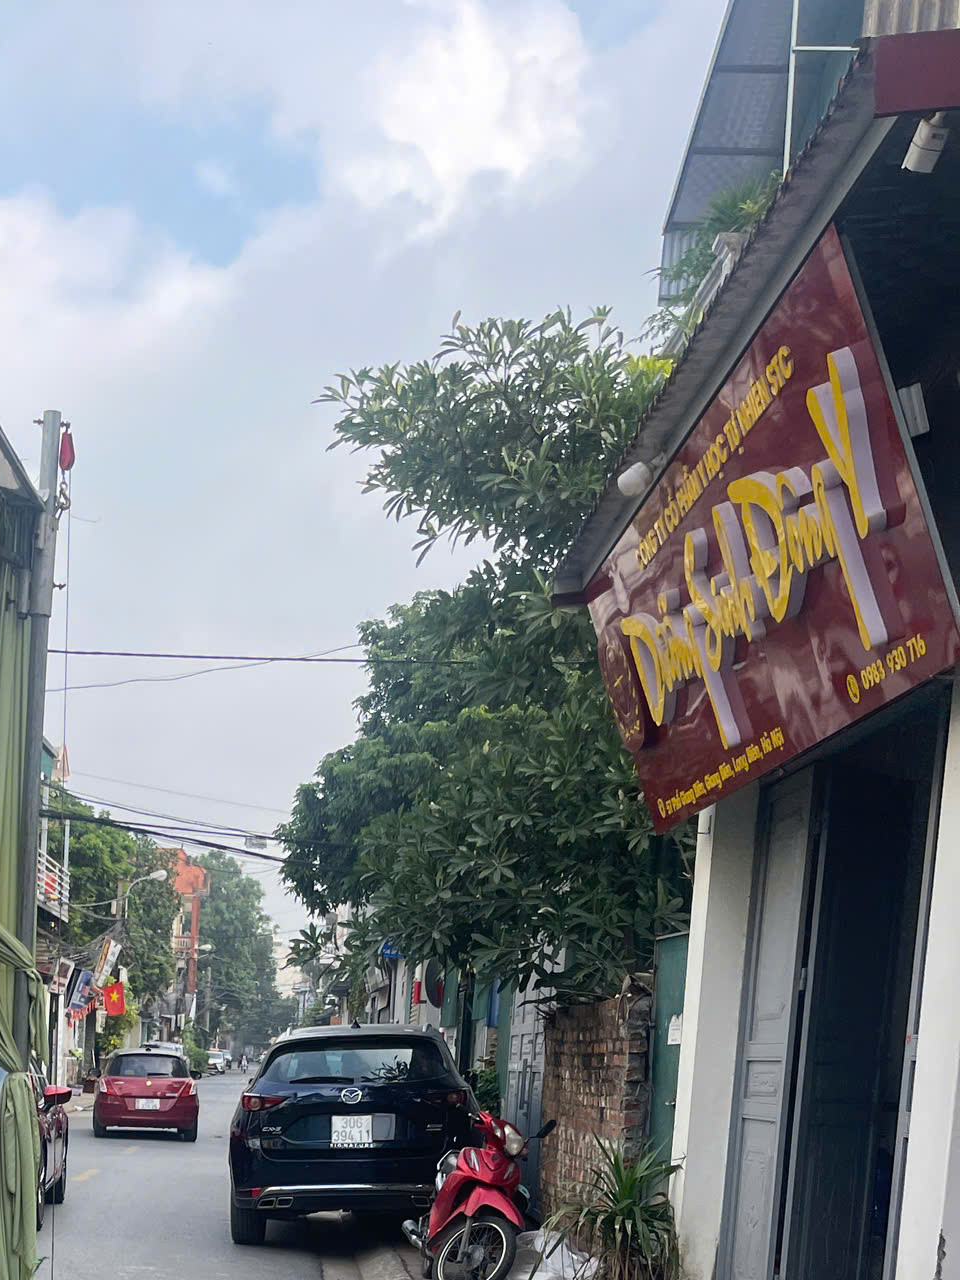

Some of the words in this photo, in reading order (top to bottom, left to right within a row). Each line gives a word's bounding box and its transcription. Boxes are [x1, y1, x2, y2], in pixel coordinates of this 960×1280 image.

[766, 344, 795, 397] STC
[861, 658, 886, 690] 0983
[886, 646, 907, 674] 930
[906, 633, 927, 664] 716
